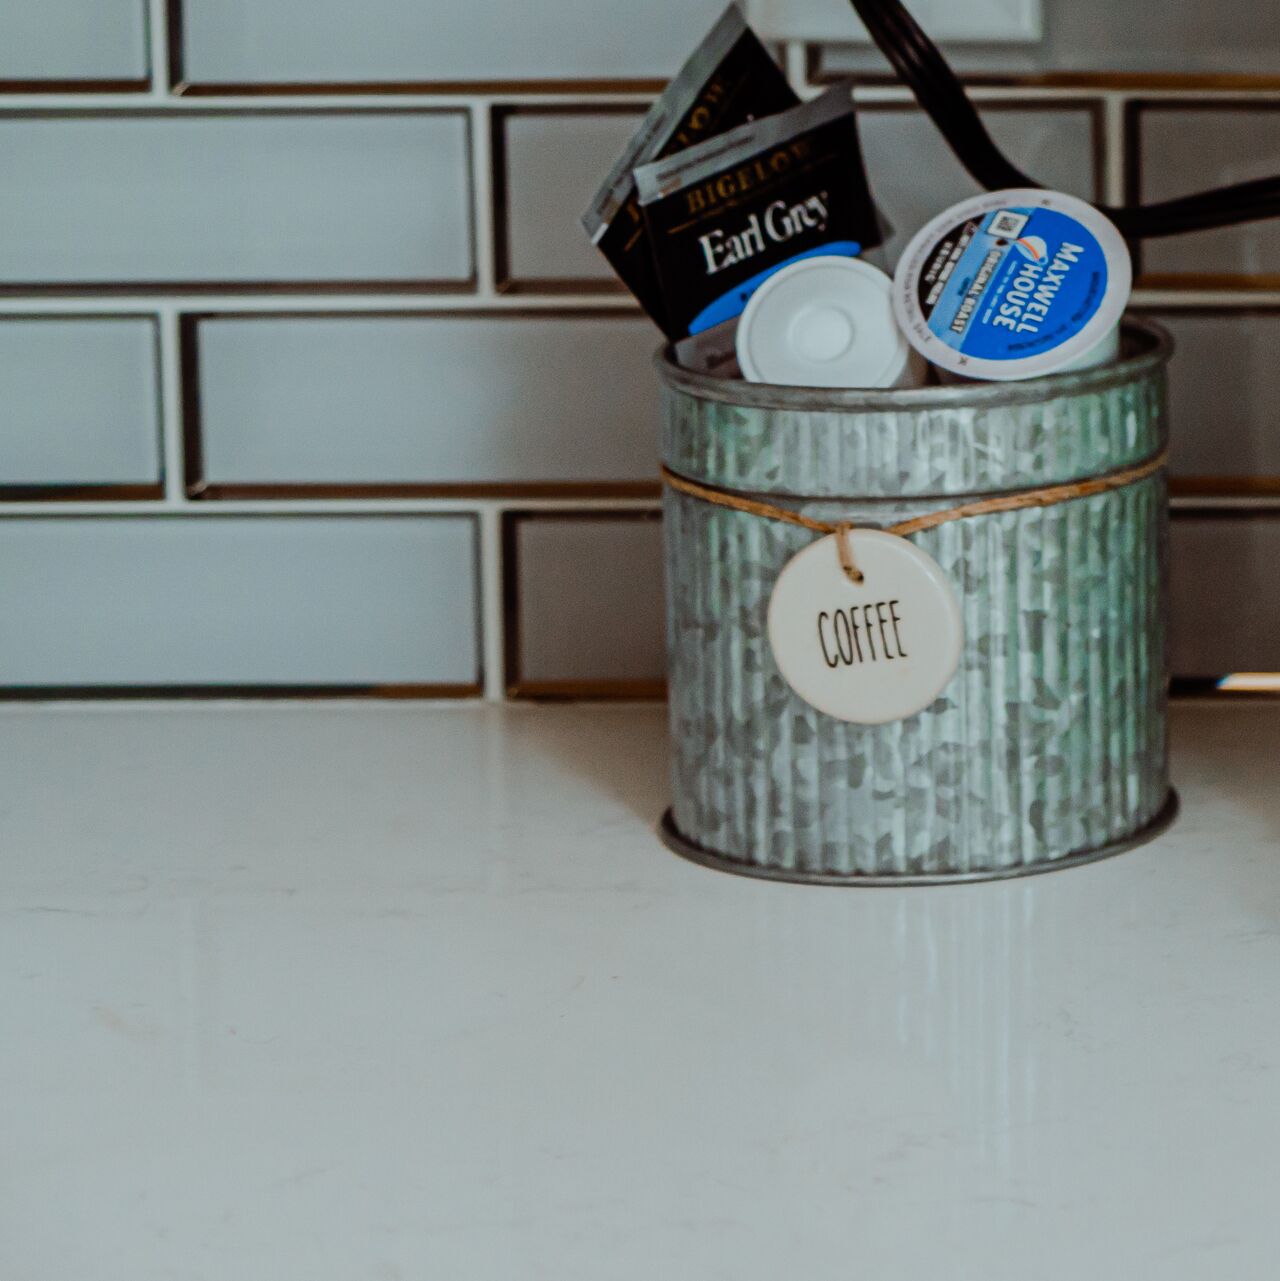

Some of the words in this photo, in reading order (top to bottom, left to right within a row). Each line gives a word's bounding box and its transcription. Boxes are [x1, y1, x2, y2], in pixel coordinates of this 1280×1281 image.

[685, 138, 815, 214] BIGELOW
[698, 213, 766, 275] Earl
[764, 190, 829, 243] Grey
[967, 248, 1002, 296] ORIGINAL
[992, 263, 1043, 331] HOUSE
[1015, 241, 1085, 333] MAXWELL
[950, 297, 976, 334] ROAST
[817, 599, 908, 669] COFFEE
